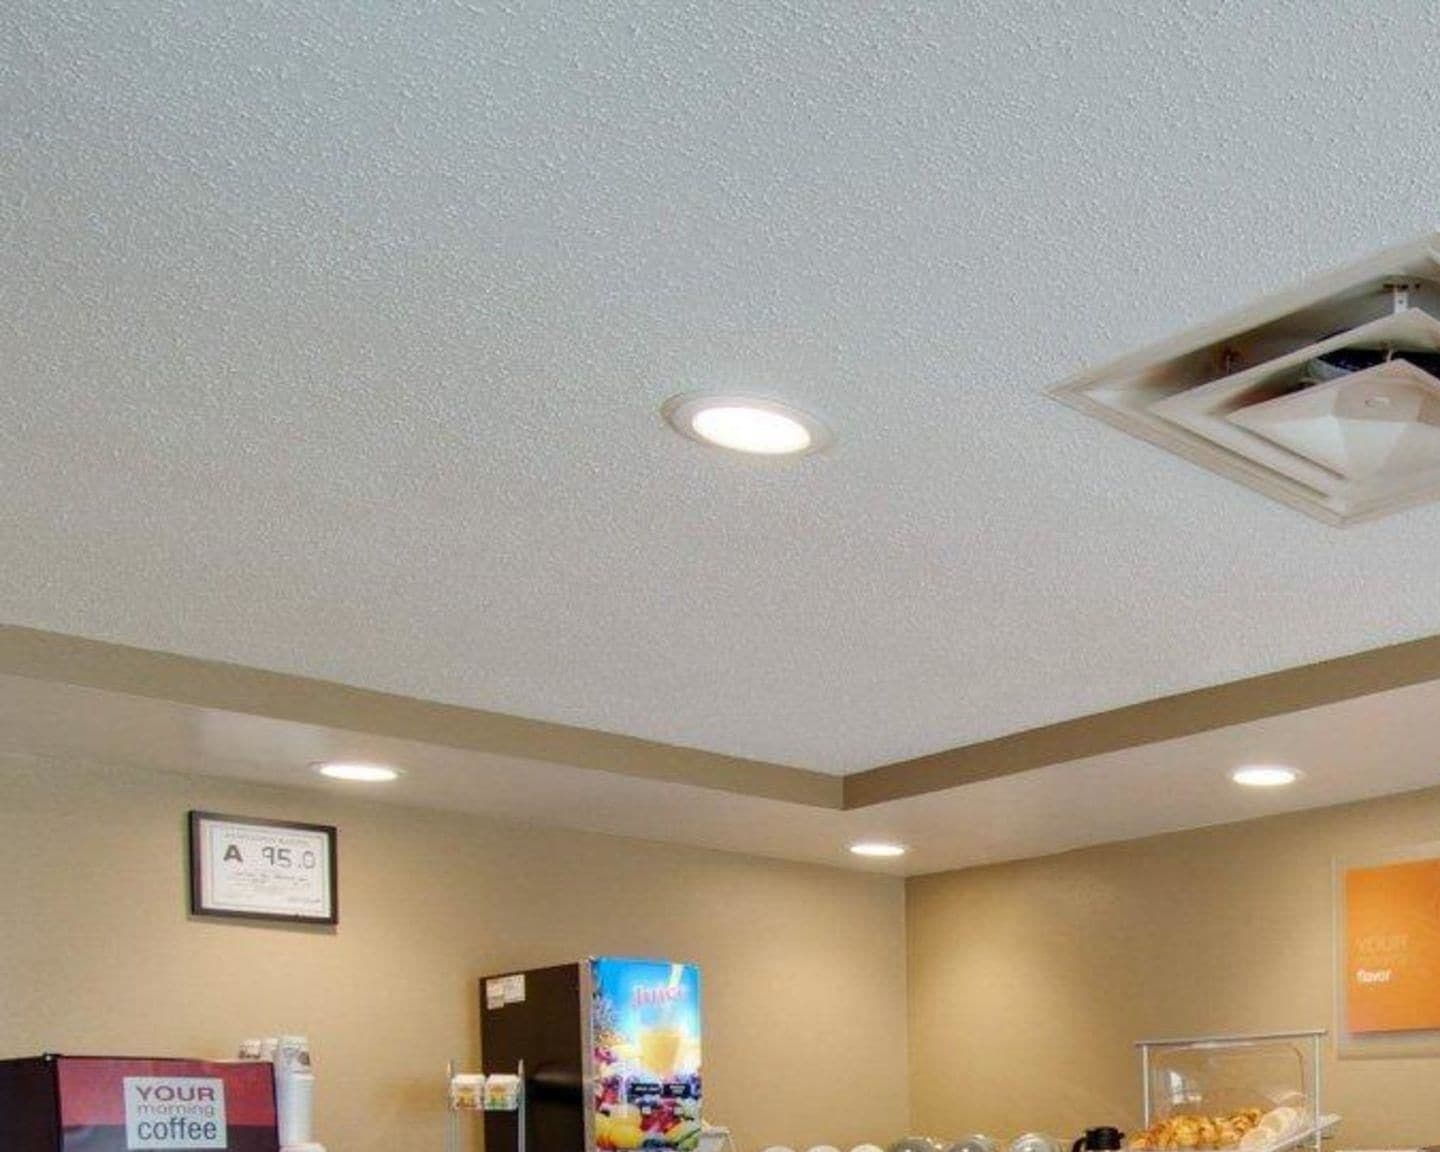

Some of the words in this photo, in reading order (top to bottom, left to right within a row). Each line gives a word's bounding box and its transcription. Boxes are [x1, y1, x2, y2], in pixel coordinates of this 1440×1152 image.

[222, 844, 244, 863] A
[135, 1085, 215, 1101] YOUR
[138, 1104, 214, 1118] morning
[138, 1116, 217, 1140] coffee
